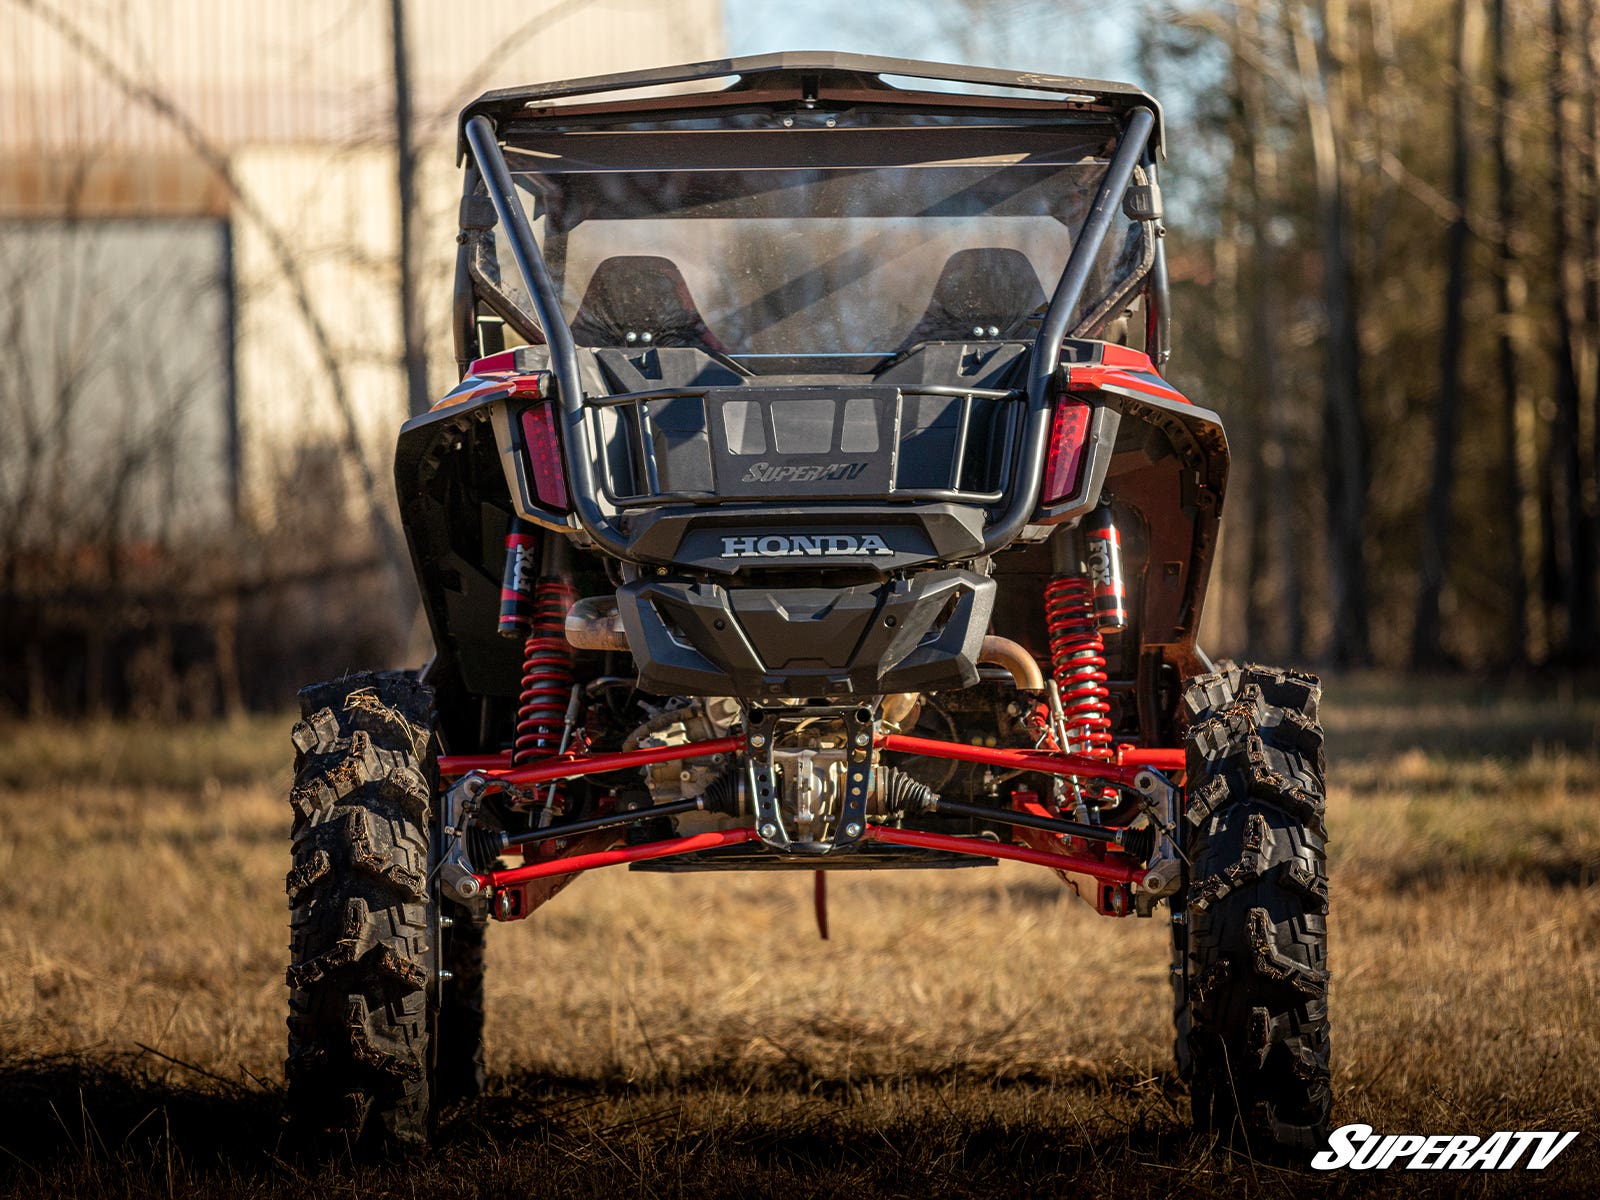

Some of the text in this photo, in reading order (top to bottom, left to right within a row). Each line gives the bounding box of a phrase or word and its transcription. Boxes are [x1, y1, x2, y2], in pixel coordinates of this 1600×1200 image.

[513, 544, 535, 591] FOX
[721, 535, 894, 557] HONDA
[1089, 540, 1111, 588] FOX
